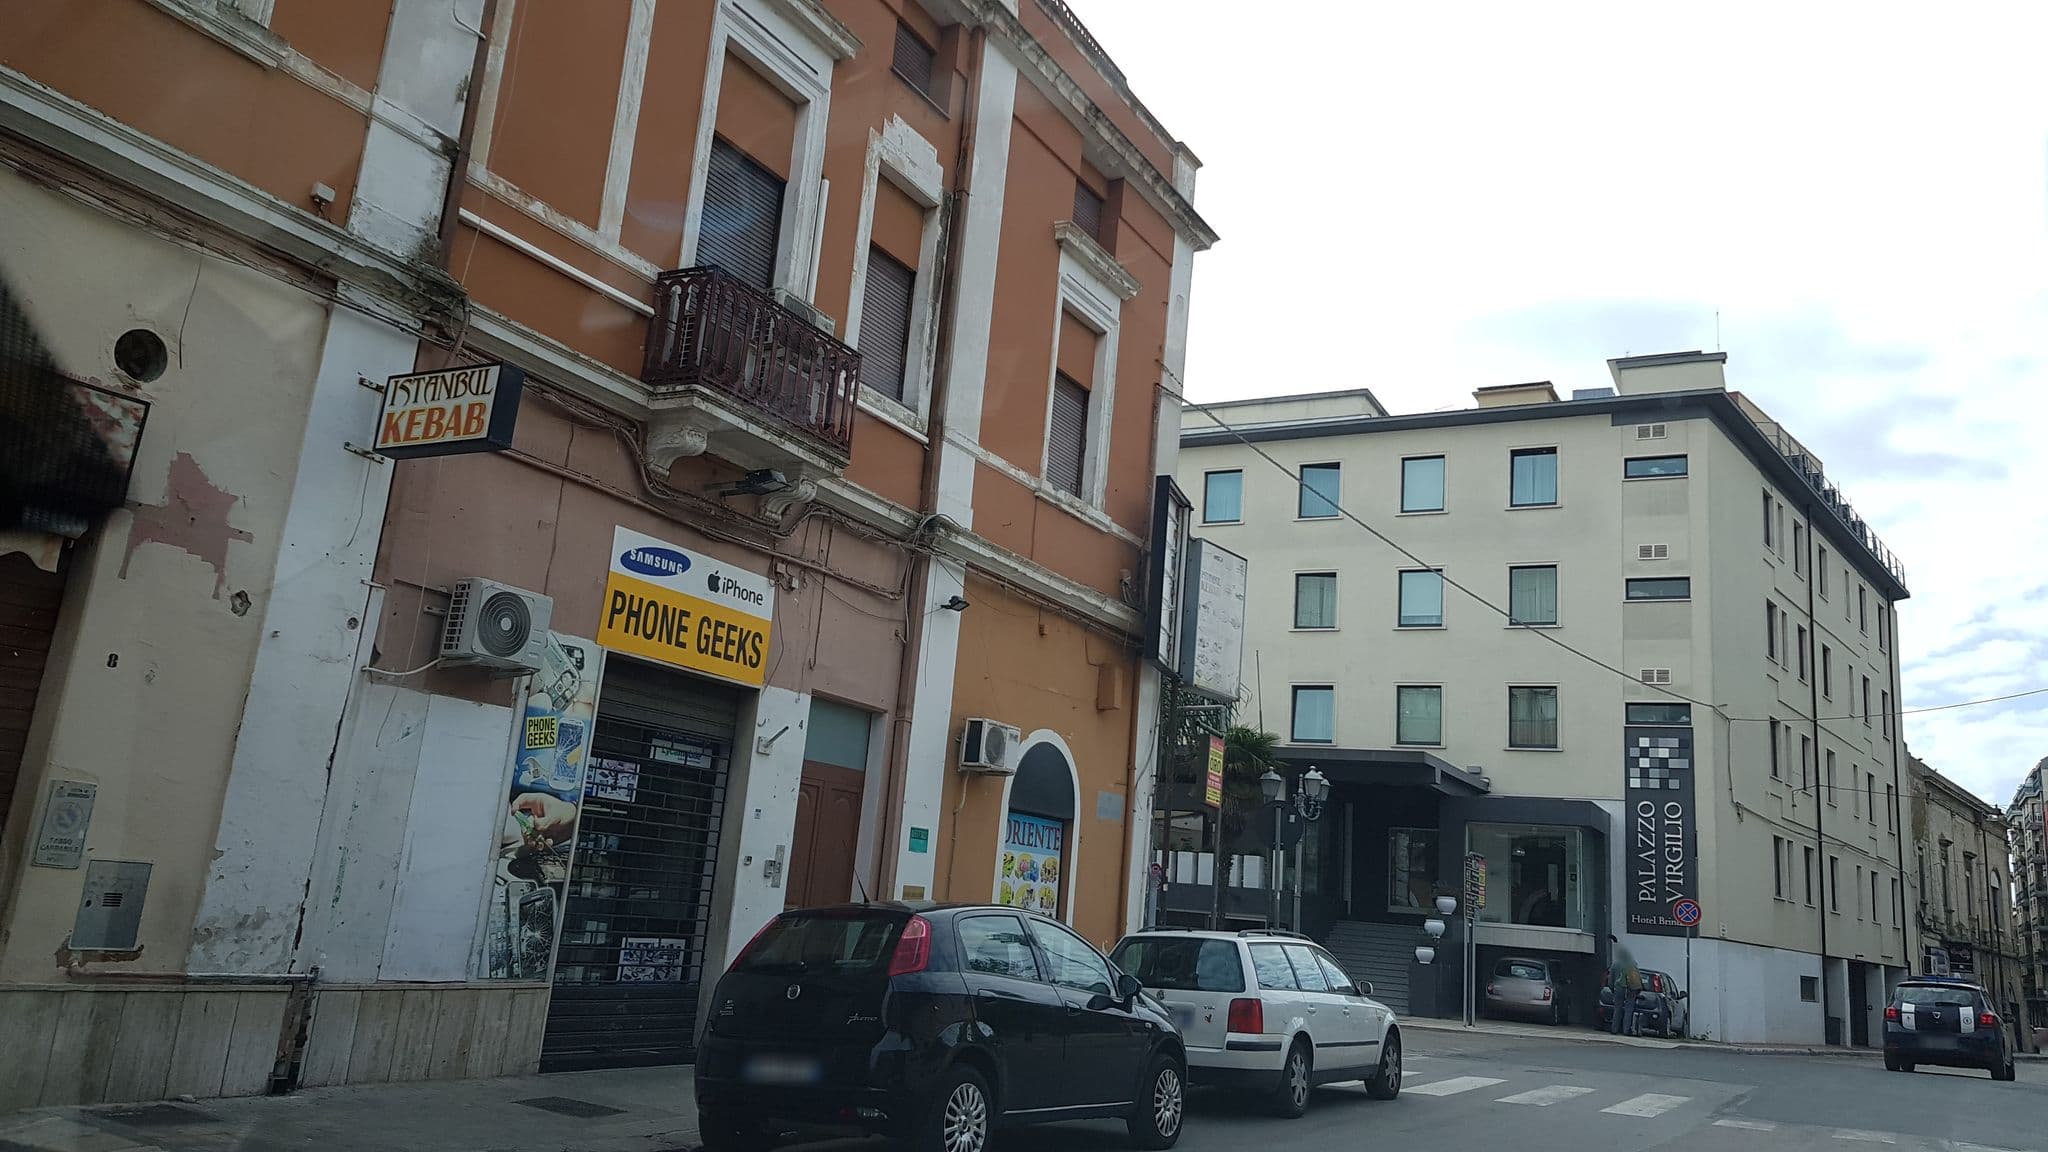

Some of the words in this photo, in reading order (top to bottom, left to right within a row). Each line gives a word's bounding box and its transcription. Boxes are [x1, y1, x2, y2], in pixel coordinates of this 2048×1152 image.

[381, 402, 486, 444] KEBAB
[629, 548, 684, 575] SAMSUNG
[722, 576, 764, 606] iPhone
[608, 590, 690, 649] PHONE
[696, 615, 763, 668] GEEKS
[107, 652, 118, 667] 8
[527, 731, 555, 746] GEEKS
[528, 717, 555, 732] PHONE
[1638, 800, 1656, 903] PALAZZO
[1664, 801, 1683, 903] VIRGILIO
[1631, 914, 1656, 925] Hotel
